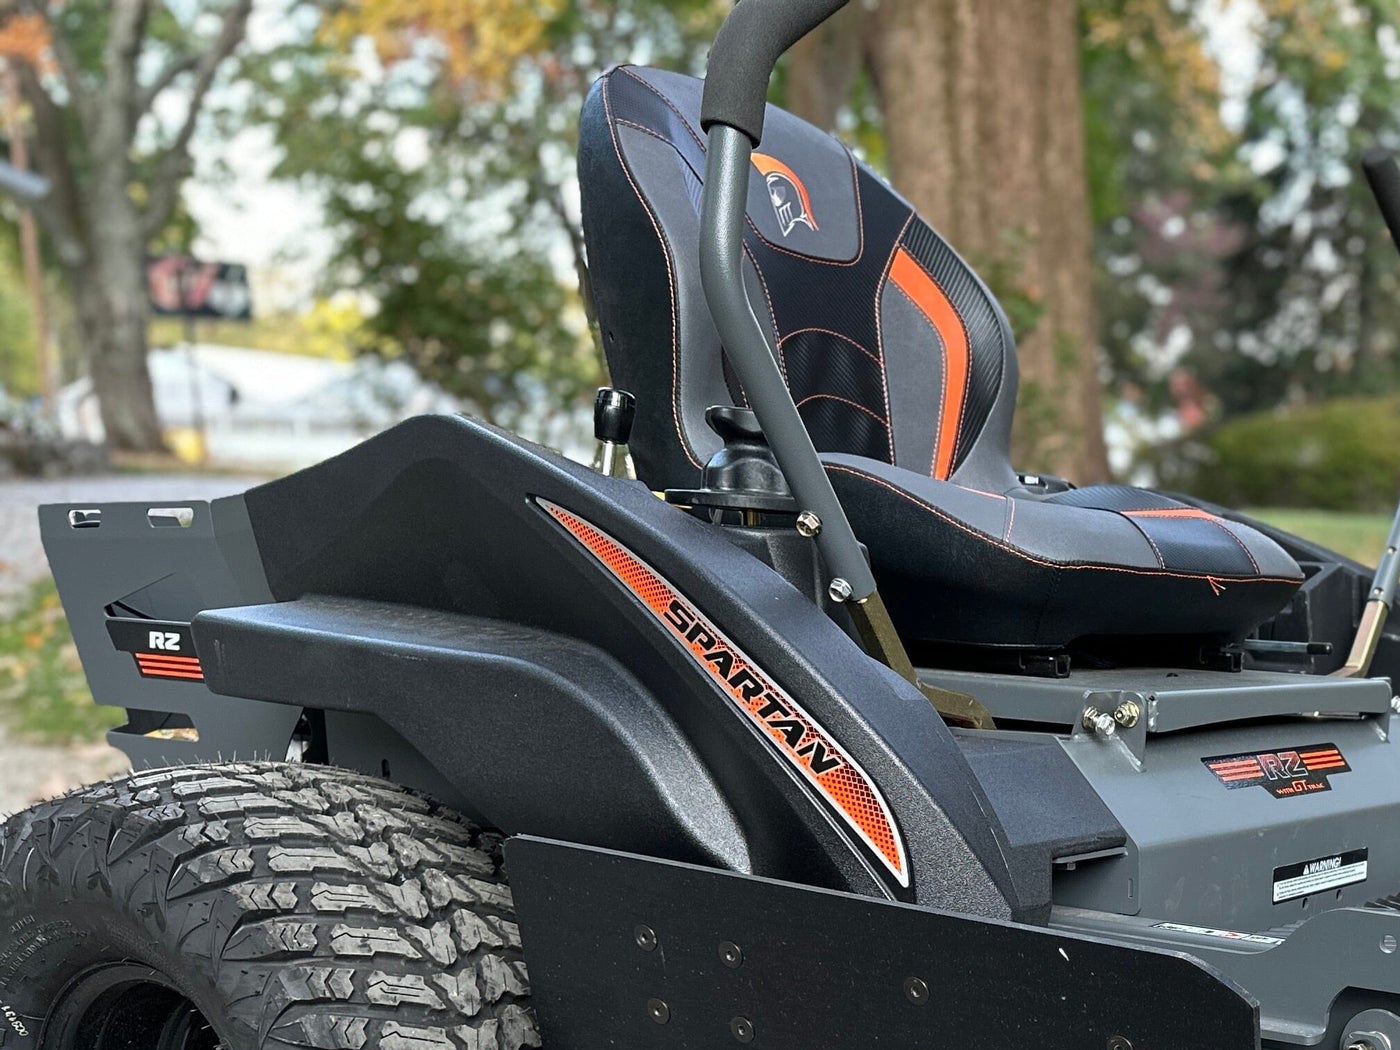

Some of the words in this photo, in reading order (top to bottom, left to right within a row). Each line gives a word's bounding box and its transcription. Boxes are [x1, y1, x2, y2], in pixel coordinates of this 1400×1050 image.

[148, 631, 181, 651] RZ
[663, 599, 842, 776] SPARTAN
[1256, 750, 1309, 781] RZ
[1291, 780, 1307, 792] GT
[1309, 856, 1342, 873] WARNING!
